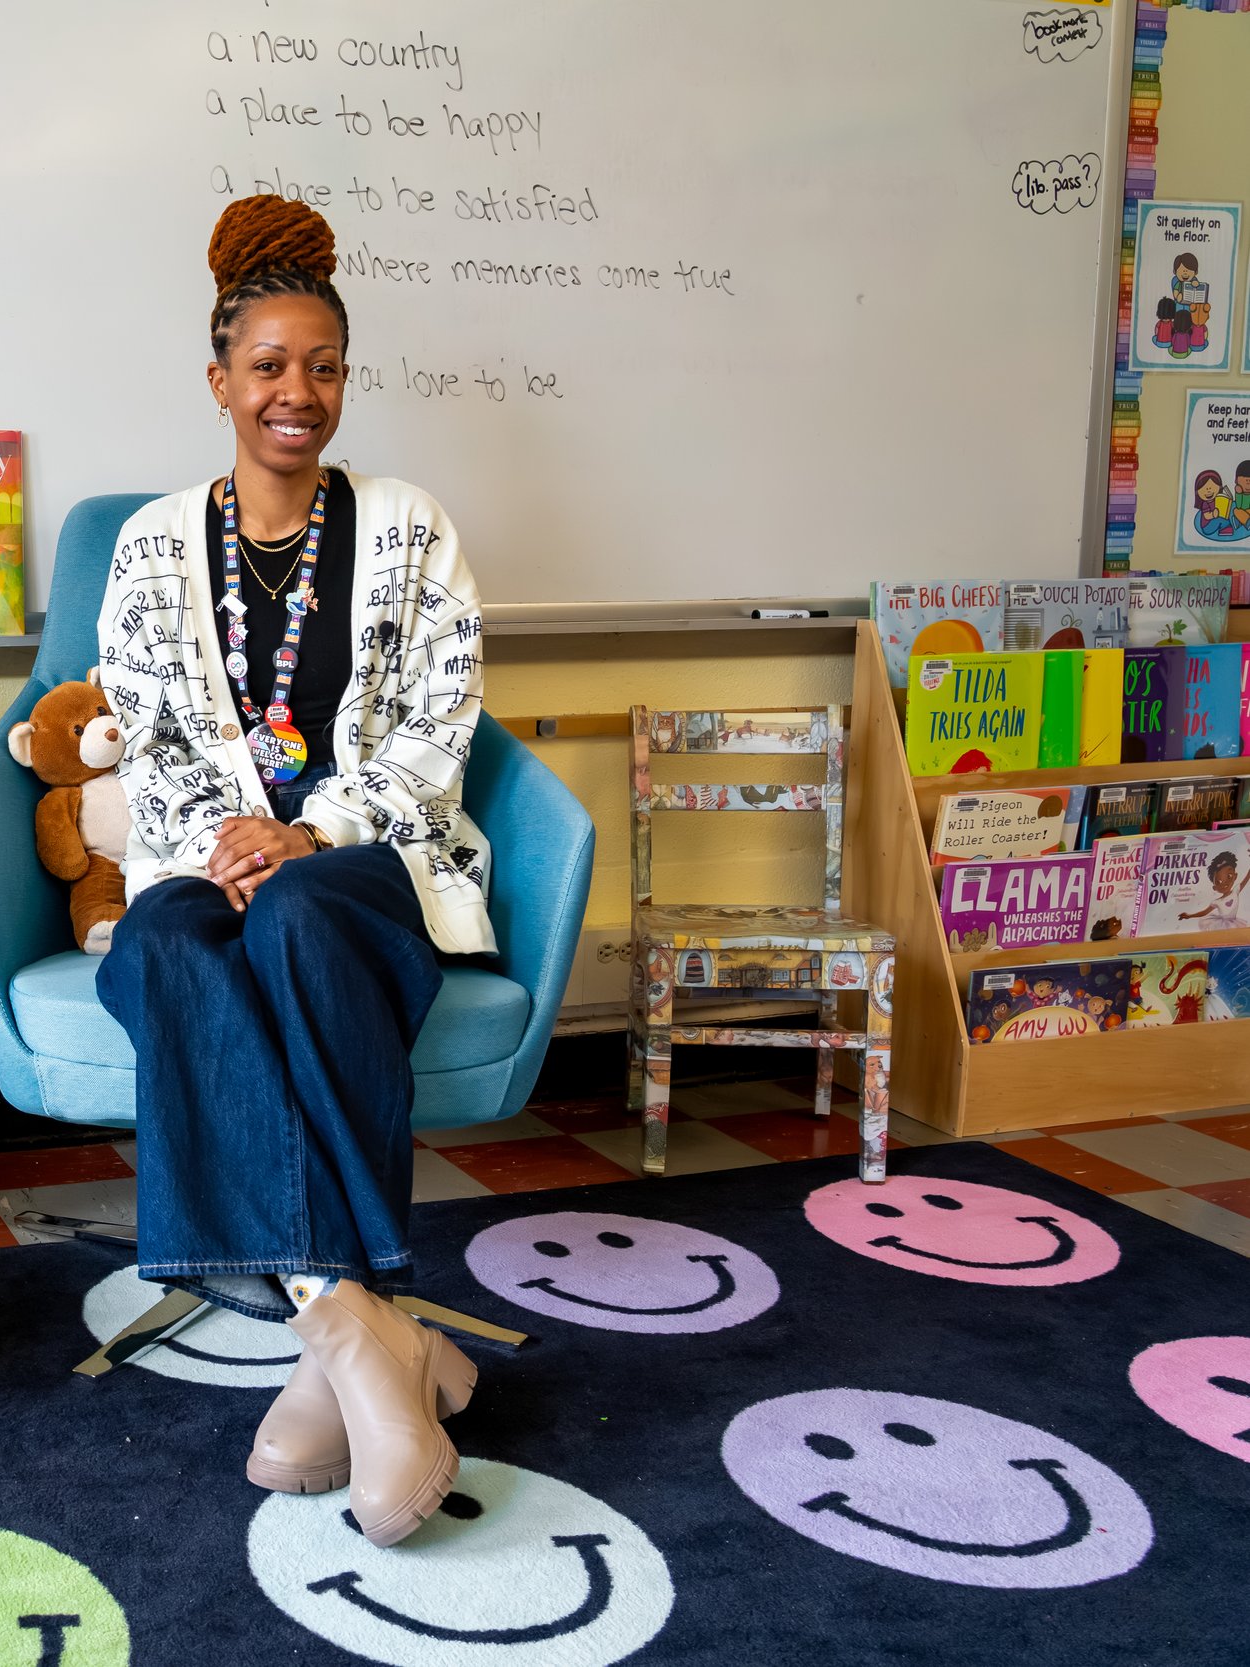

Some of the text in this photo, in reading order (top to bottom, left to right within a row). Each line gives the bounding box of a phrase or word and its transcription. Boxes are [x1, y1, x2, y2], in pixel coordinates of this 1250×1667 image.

[207, 31, 464, 90] a new country
[206, 87, 542, 156] a place to be happy
[210, 165, 234, 197] a
[346, 176, 383, 213] to
[392, 176, 436, 214] be
[454, 183, 599, 226] satisfied
[1156, 216, 1221, 231] Sit quietly on
[1164, 231, 1211, 242] the floor.
[451, 256, 581, 289] memories
[597, 262, 661, 291] come
[673, 259, 735, 296] true
[402, 356, 463, 398] love
[474, 369, 506, 402] to
[523, 365, 564, 399] be
[1208, 403, 1232, 417] Keep
[1207, 418, 1248, 429] and feet
[919, 585, 1001, 609] BIG CHEESE
[1033, 584, 1078, 605] COUCH
[1150, 587, 1227, 609] SOUR GRAPE
[276, 660, 294, 668] BPL
[952, 668, 1007, 703] TILDA
[930, 706, 1026, 743] TRIES AGAIN
[253, 732, 303, 751] EVERYONE
[270, 745, 280, 753] IS
[251, 747, 296, 764] WELCOME
[258, 758, 284, 770] HERE!
[980, 801, 1023, 813] Pigeon
[948, 815, 1037, 830] Will Ride the
[944, 830, 1048, 847] Roller Coaster!
[1154, 852, 1208, 870] PARKER
[1099, 865, 1141, 883] LOOKS
[1151, 870, 1201, 887] SHINES
[1096, 885, 1115, 901] UP
[1149, 889, 1169, 905] ON
[1004, 910, 1083, 925] UNLEASHES THE
[1002, 924, 1080, 943] ALPACALYPSE
[1004, 1016, 1088, 1040] AMY WU
